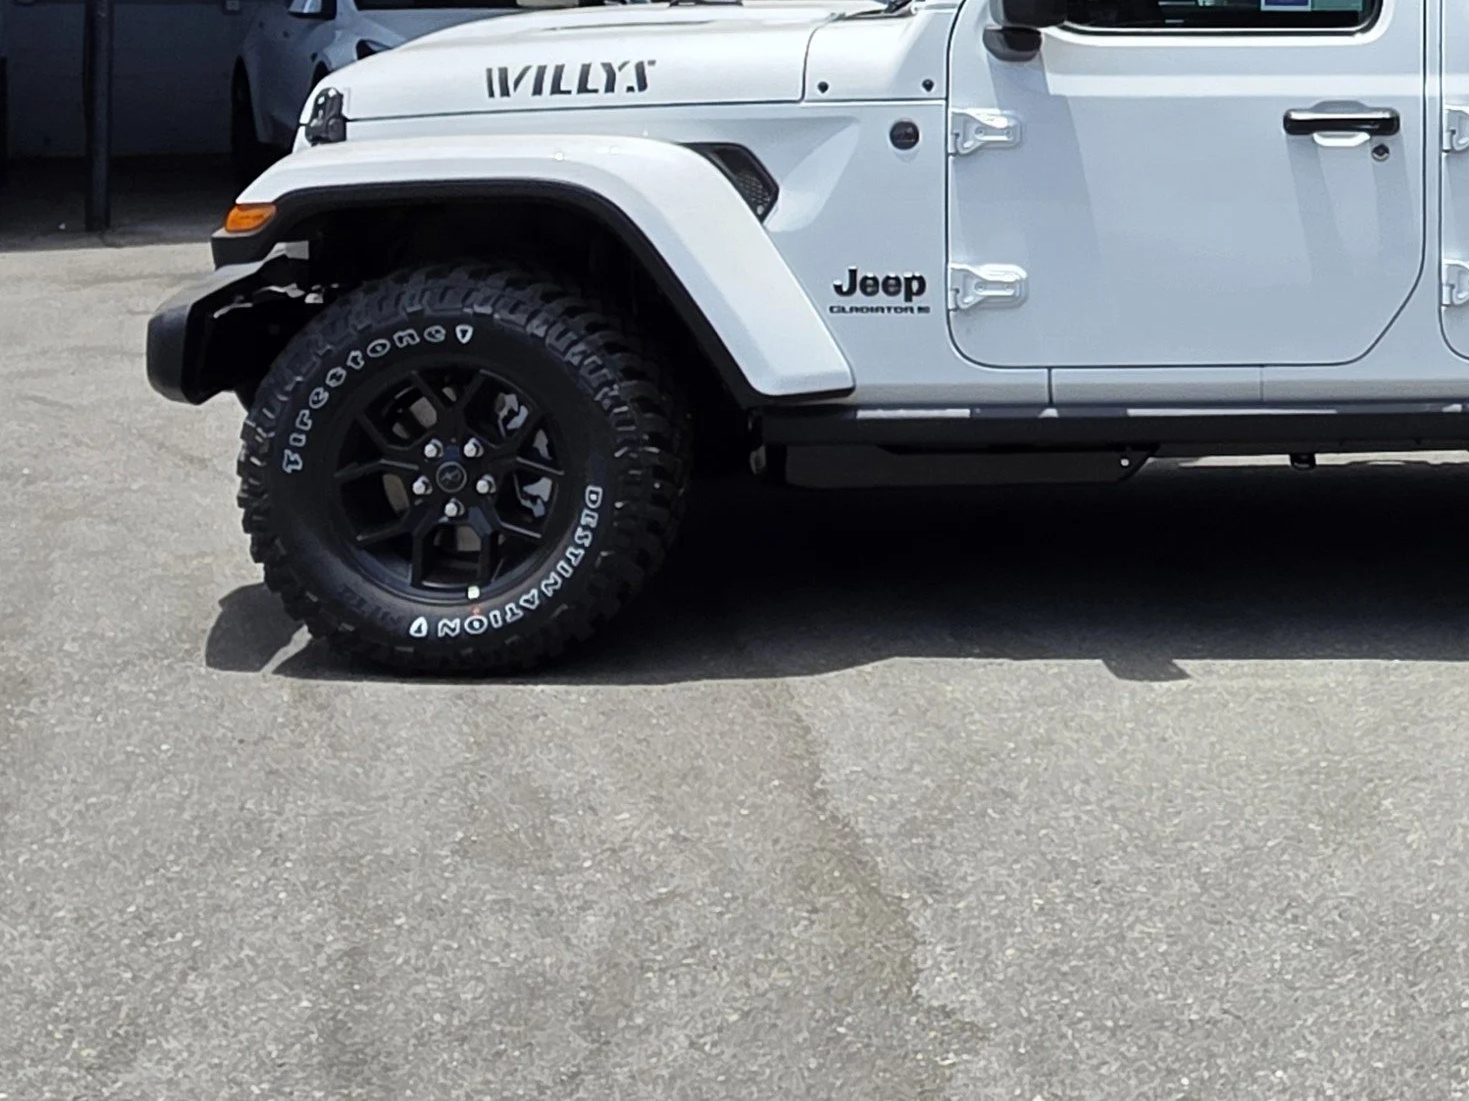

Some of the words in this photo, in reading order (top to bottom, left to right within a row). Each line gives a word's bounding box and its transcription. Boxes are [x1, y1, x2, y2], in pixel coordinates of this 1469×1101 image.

[486, 60, 656, 98] WILLYS
[833, 266, 926, 302] Jeep
[829, 305, 914, 314] GLADIATOR
[282, 324, 447, 474] Firestone
[437, 485, 603, 638] DESTINATION
